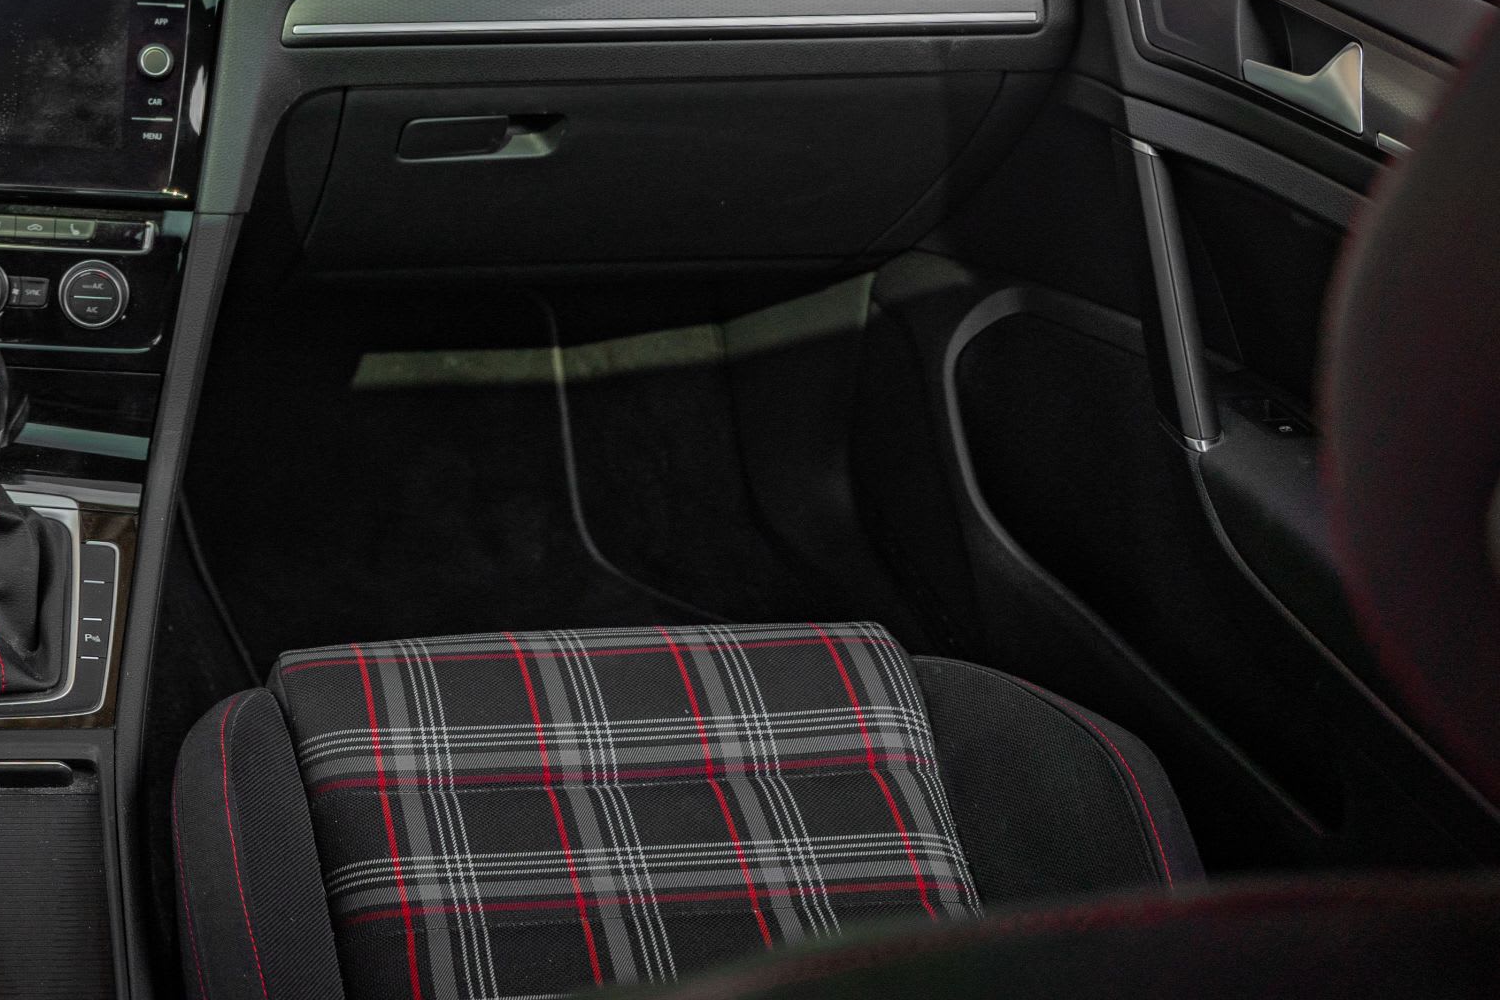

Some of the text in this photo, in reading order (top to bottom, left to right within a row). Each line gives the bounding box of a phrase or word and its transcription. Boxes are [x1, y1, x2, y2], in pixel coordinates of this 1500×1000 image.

[154, 18, 169, 26] APP
[147, 97, 163, 106] CAR
[142, 132, 163, 141] MENU
[24, 288, 41, 297] SYNC
